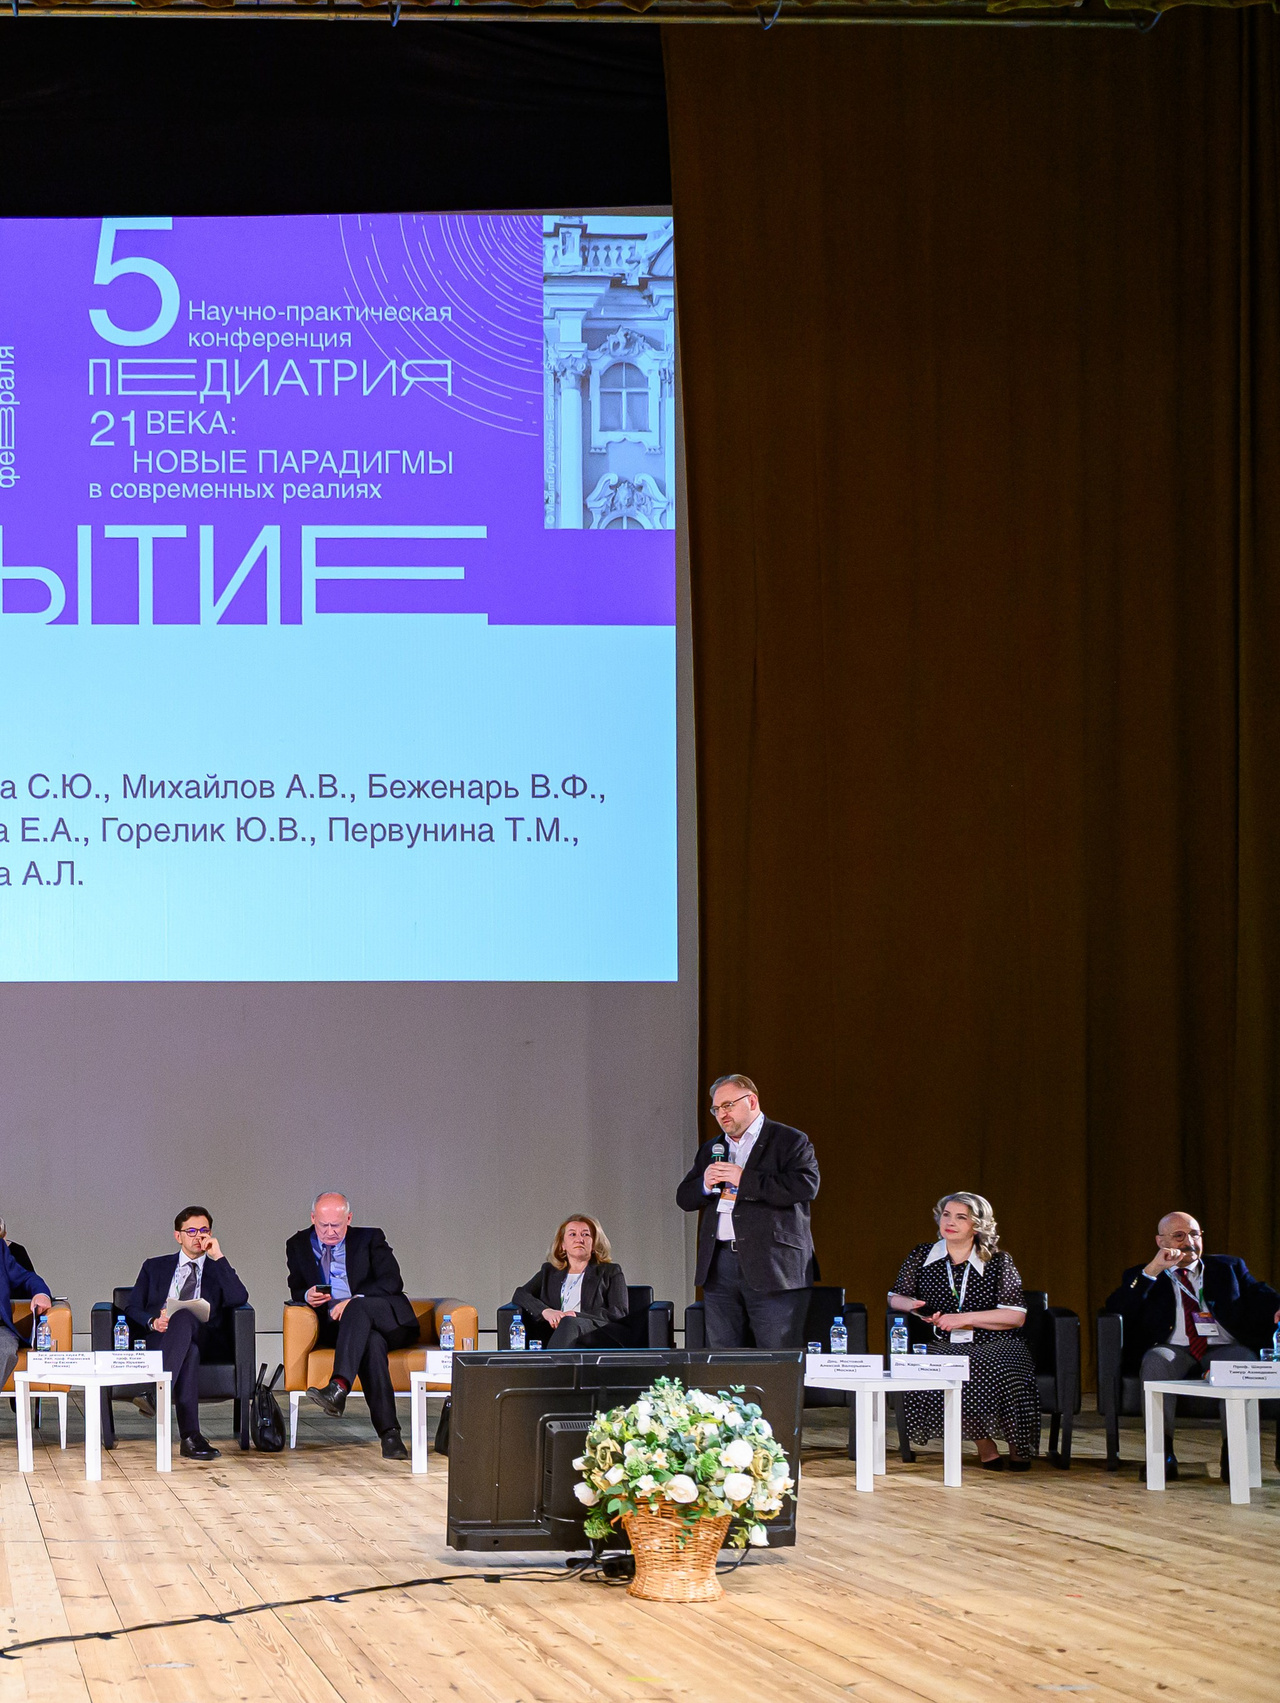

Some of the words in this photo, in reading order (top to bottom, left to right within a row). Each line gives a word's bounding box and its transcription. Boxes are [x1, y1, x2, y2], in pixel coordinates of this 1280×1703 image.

[88, 216, 181, 346] 5
[188, 299, 452, 325] Научно-практическая
[189, 327, 351, 352] конференция
[88, 360, 452, 402] ПЕДИАТРИЯ
[90, 410, 135, 446] 21
[147, 411, 235, 434] ВЕКА:
[134, 450, 247, 473] НОВЫЕ
[259, 450, 452, 478] ПАРАДИГМЫ
[90, 483, 102, 498] в
[111, 483, 274, 503] современных
[283, 483, 382, 503] реалиях
[28, 773, 109, 803] С.Ю.,
[123, 774, 275, 799] Михайлов
[286, 774, 355, 803] А.В.,
[369, 774, 519, 805] Беженарь
[532, 774, 604, 803] В.Ф.,
[21, 817, 88, 846] Е.А.,
[102, 818, 225, 849] Горелик
[237, 817, 315, 846] Ю.В.,
[329, 817, 495, 848] Первунина
[505, 817, 578, 846] Т.М.,
[22, 861, 83, 886] А.Л.
